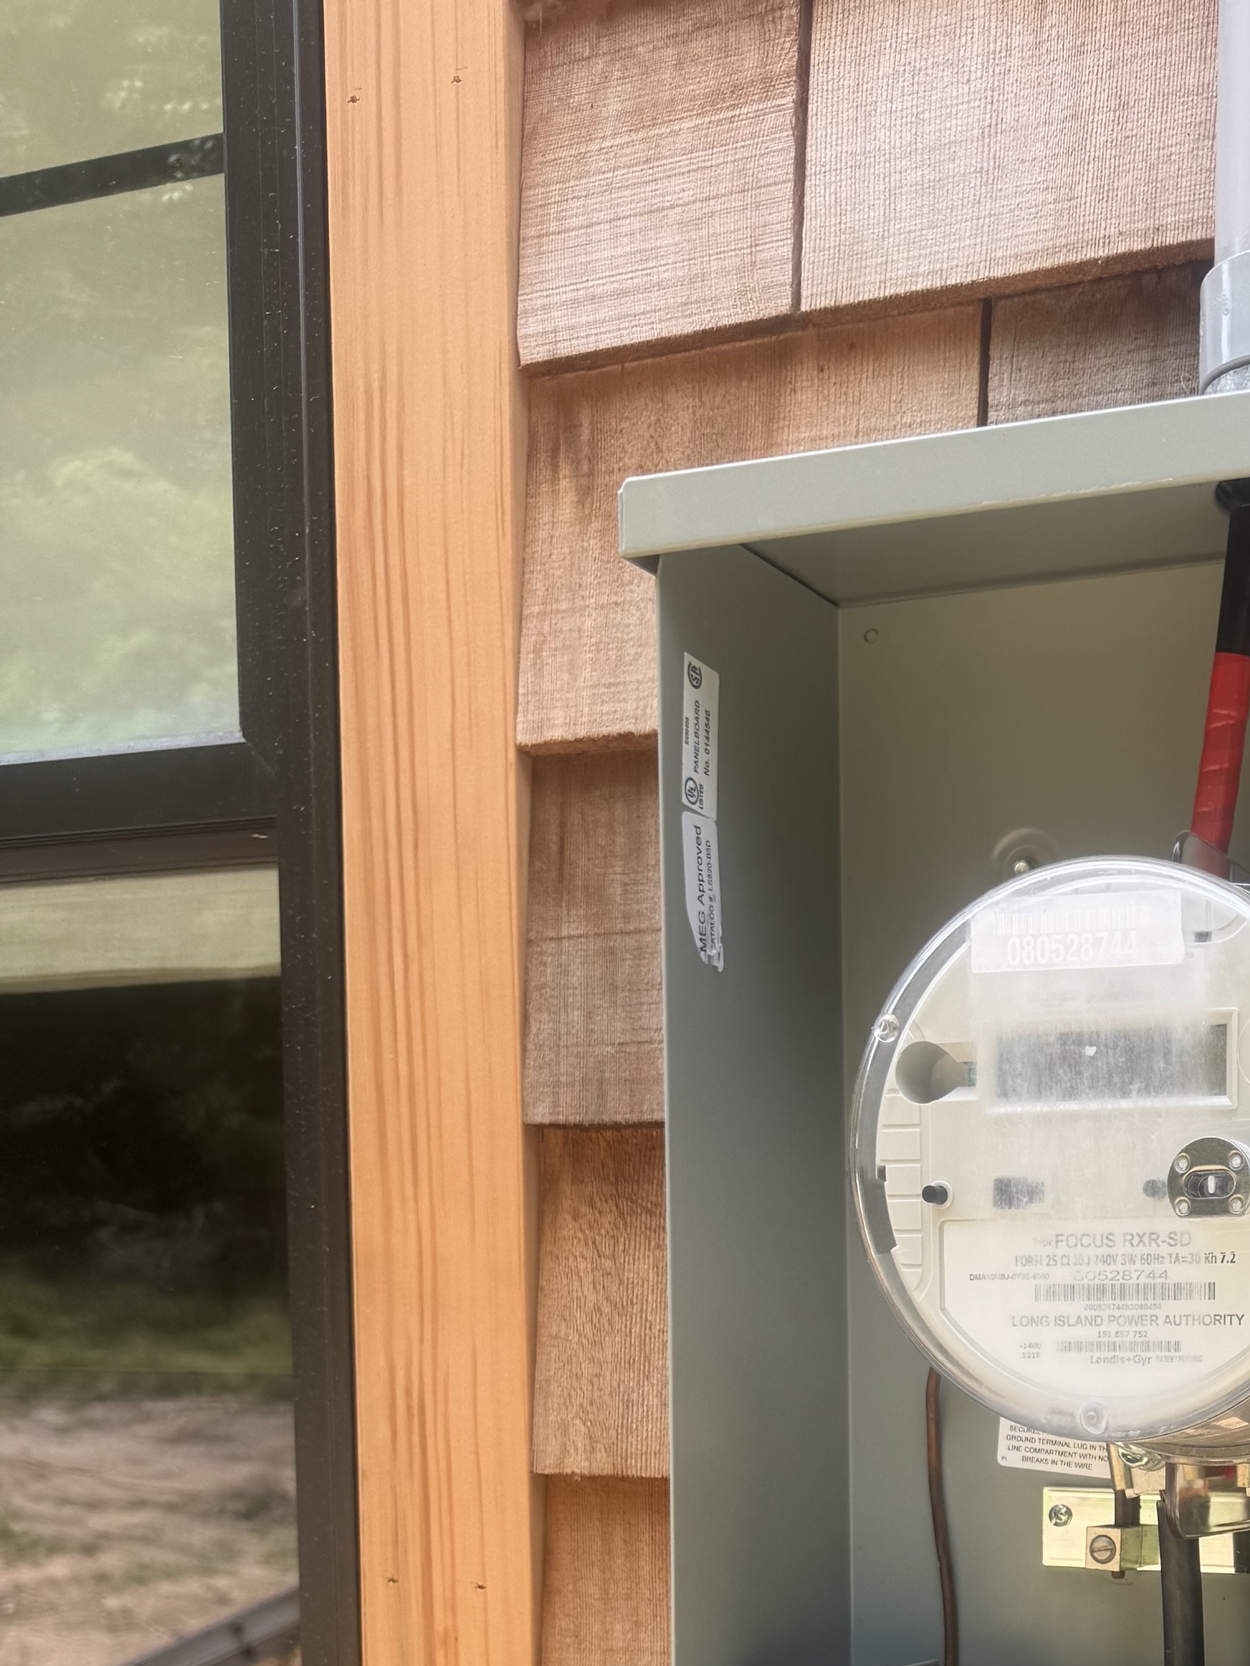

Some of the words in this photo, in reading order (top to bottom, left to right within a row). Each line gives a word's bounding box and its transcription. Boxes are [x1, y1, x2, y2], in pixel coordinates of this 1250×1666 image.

[693, 825, 706, 906] Approved
[1007, 930, 1137, 965] 080528744
[1055, 1233, 1116, 1249] FOCUS
[1122, 1232, 1192, 1248] RXR-SD
[1046, 1255, 1058, 1266] 2S
[1121, 1253, 1137, 1265] 3W
[1140, 1253, 1165, 1265] 60Hz
[1204, 1252, 1217, 1264] Kh
[1219, 1251, 1236, 1264] 7.2
[1011, 1315, 1050, 1327] LONG
[1054, 1314, 1103, 1327] ISLAND
[1107, 1314, 1159, 1327] POWER
[1163, 1314, 1245, 1326] AUTHORITY
[1006, 1434, 1036, 1444] GROUND
[1038, 1438, 1071, 1448] TERMINAL
[1074, 1441, 1088, 1450] LUG
[1090, 1443, 1097, 1451] IN
[1024, 1446, 1077, 1458] COMPARTMENT
[1079, 1452, 1097, 1461] WITH
[1022, 1455, 1049, 1465] BREAKS
[1060, 1460, 1073, 1468] THE
[1074, 1462, 1092, 1470] WIRE
